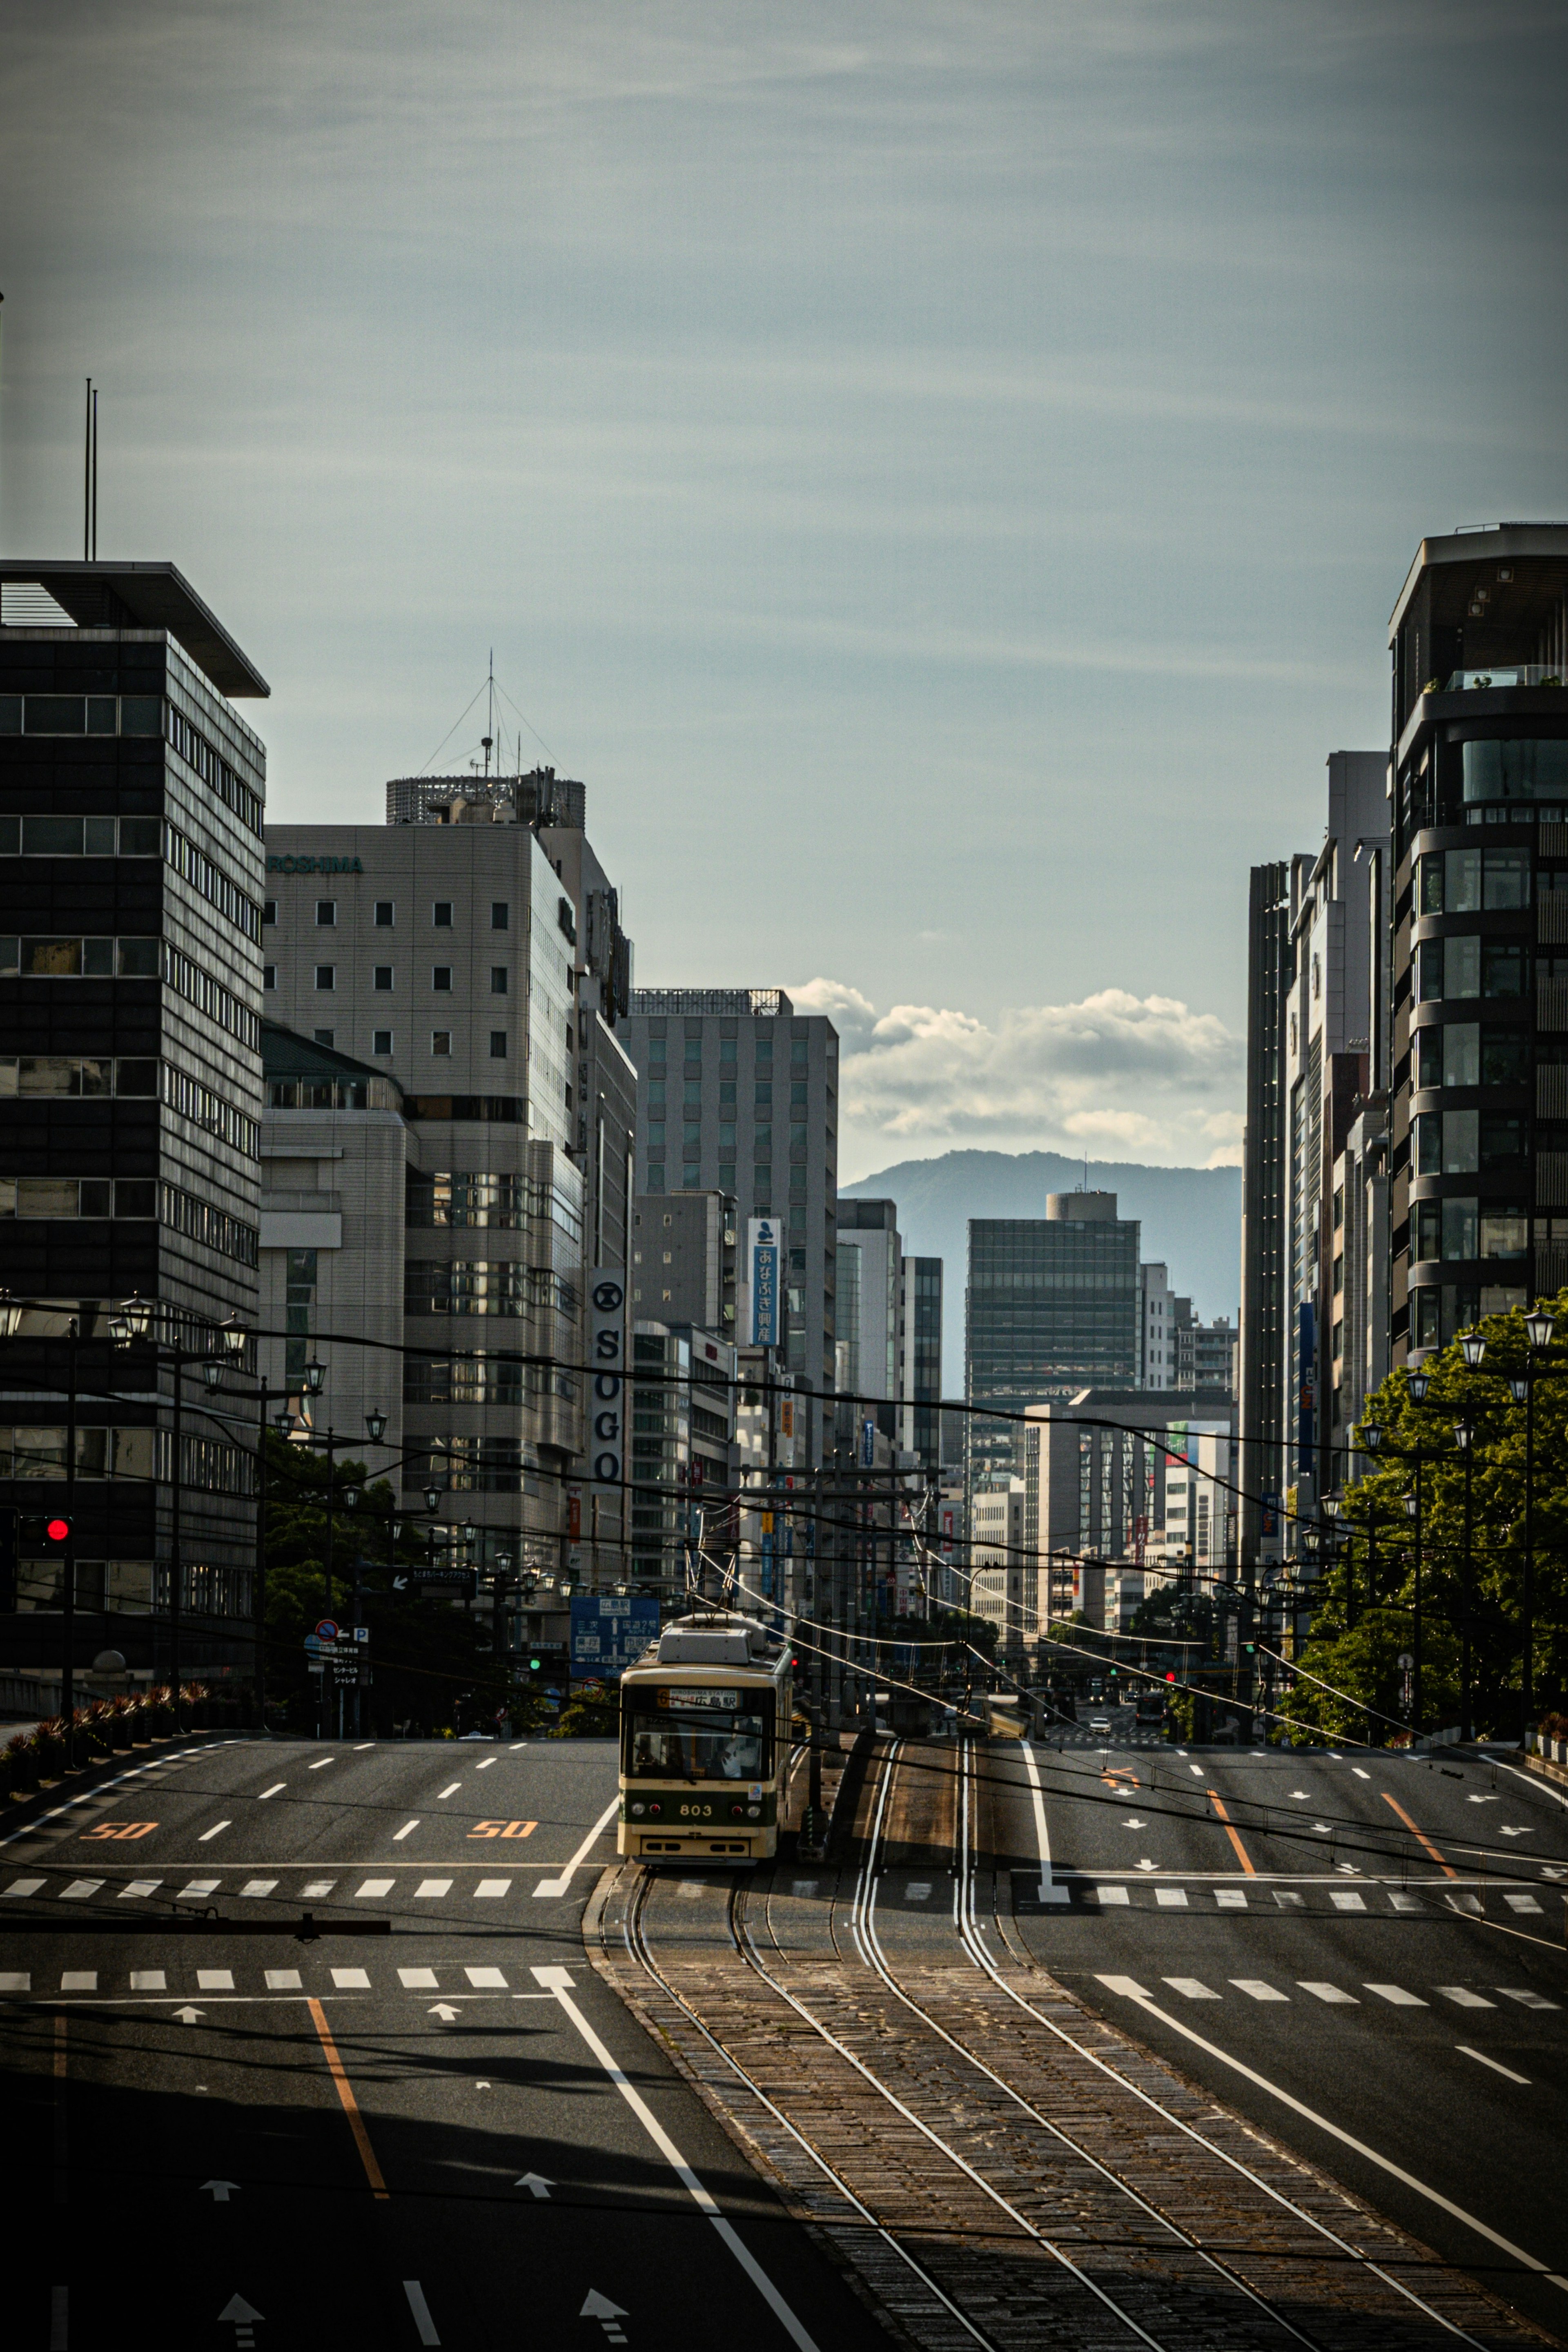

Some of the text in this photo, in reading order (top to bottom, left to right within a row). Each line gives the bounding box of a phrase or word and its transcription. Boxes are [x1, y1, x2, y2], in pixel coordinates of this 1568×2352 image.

[758, 1249, 772, 1342] あなぶき興産
[594, 1329, 620, 1480] SOGO
[601, 1599, 629, 1609] 広島駅
[356, 1629, 366, 1642] P
[334, 1676, 356, 1684] シャレオ
[660, 1691, 667, 1705] 6
[695, 1696, 736, 1707] 広島駅
[679, 1804, 713, 1817] 803
[79, 1822, 160, 1840] 50
[466, 1821, 539, 1838] 50
